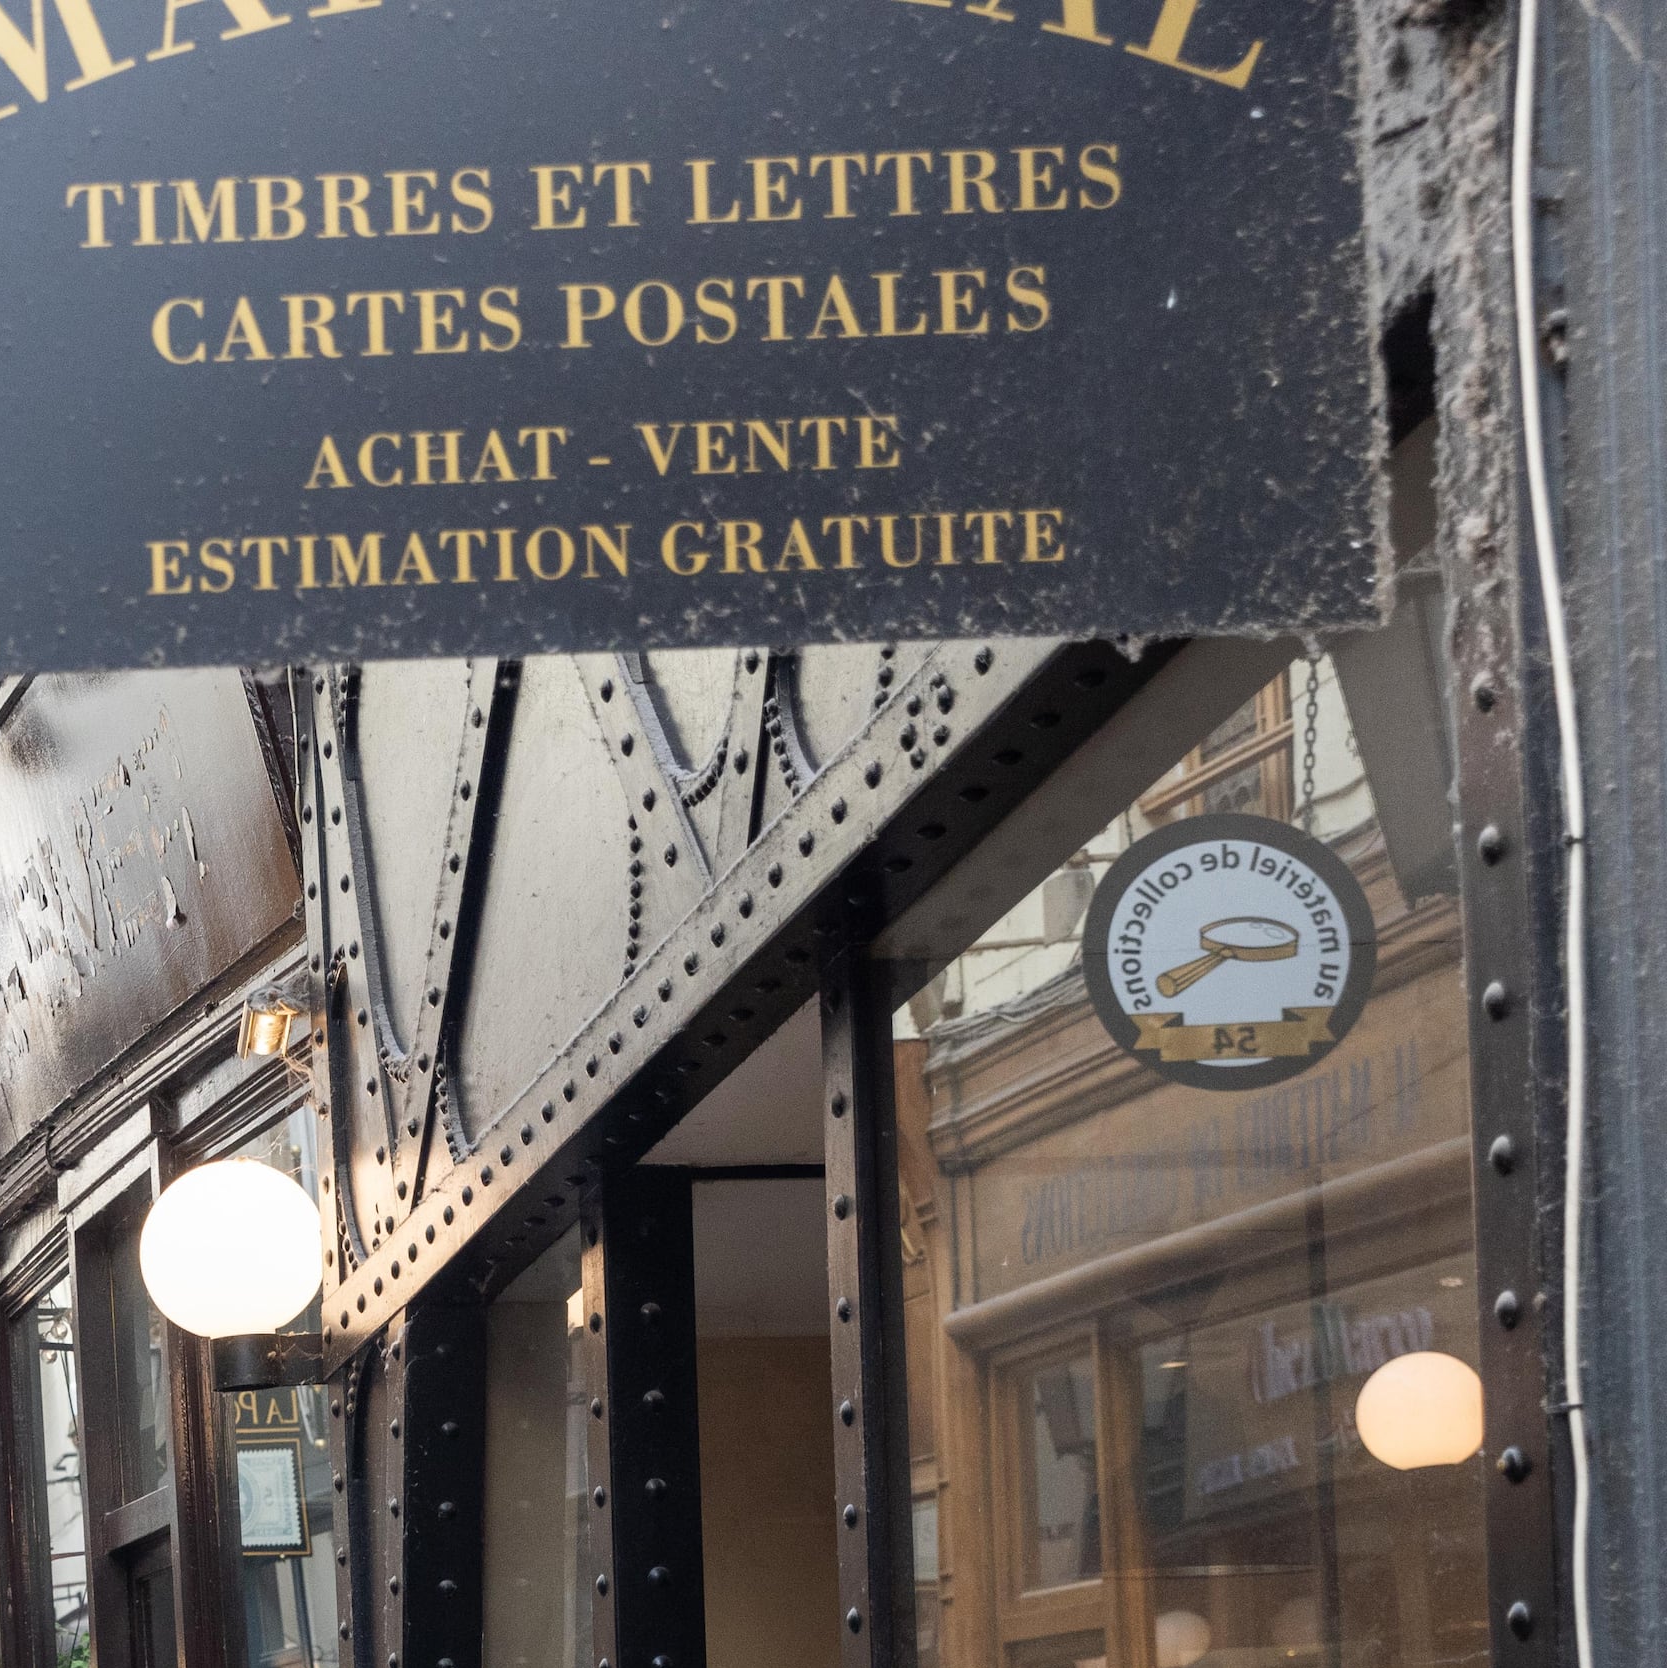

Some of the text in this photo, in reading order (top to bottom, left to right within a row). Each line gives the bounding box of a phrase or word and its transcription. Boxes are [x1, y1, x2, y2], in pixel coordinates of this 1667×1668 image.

[66, 143, 1125, 250] TIMBRES ET LETTRES
[152, 265, 1053, 366] CARTES POSTALES
[305, 424, 569, 492] ACHAT
[639, 414, 903, 479] VENTE
[145, 508, 1067, 597] ESTIMATION GRATUITE
